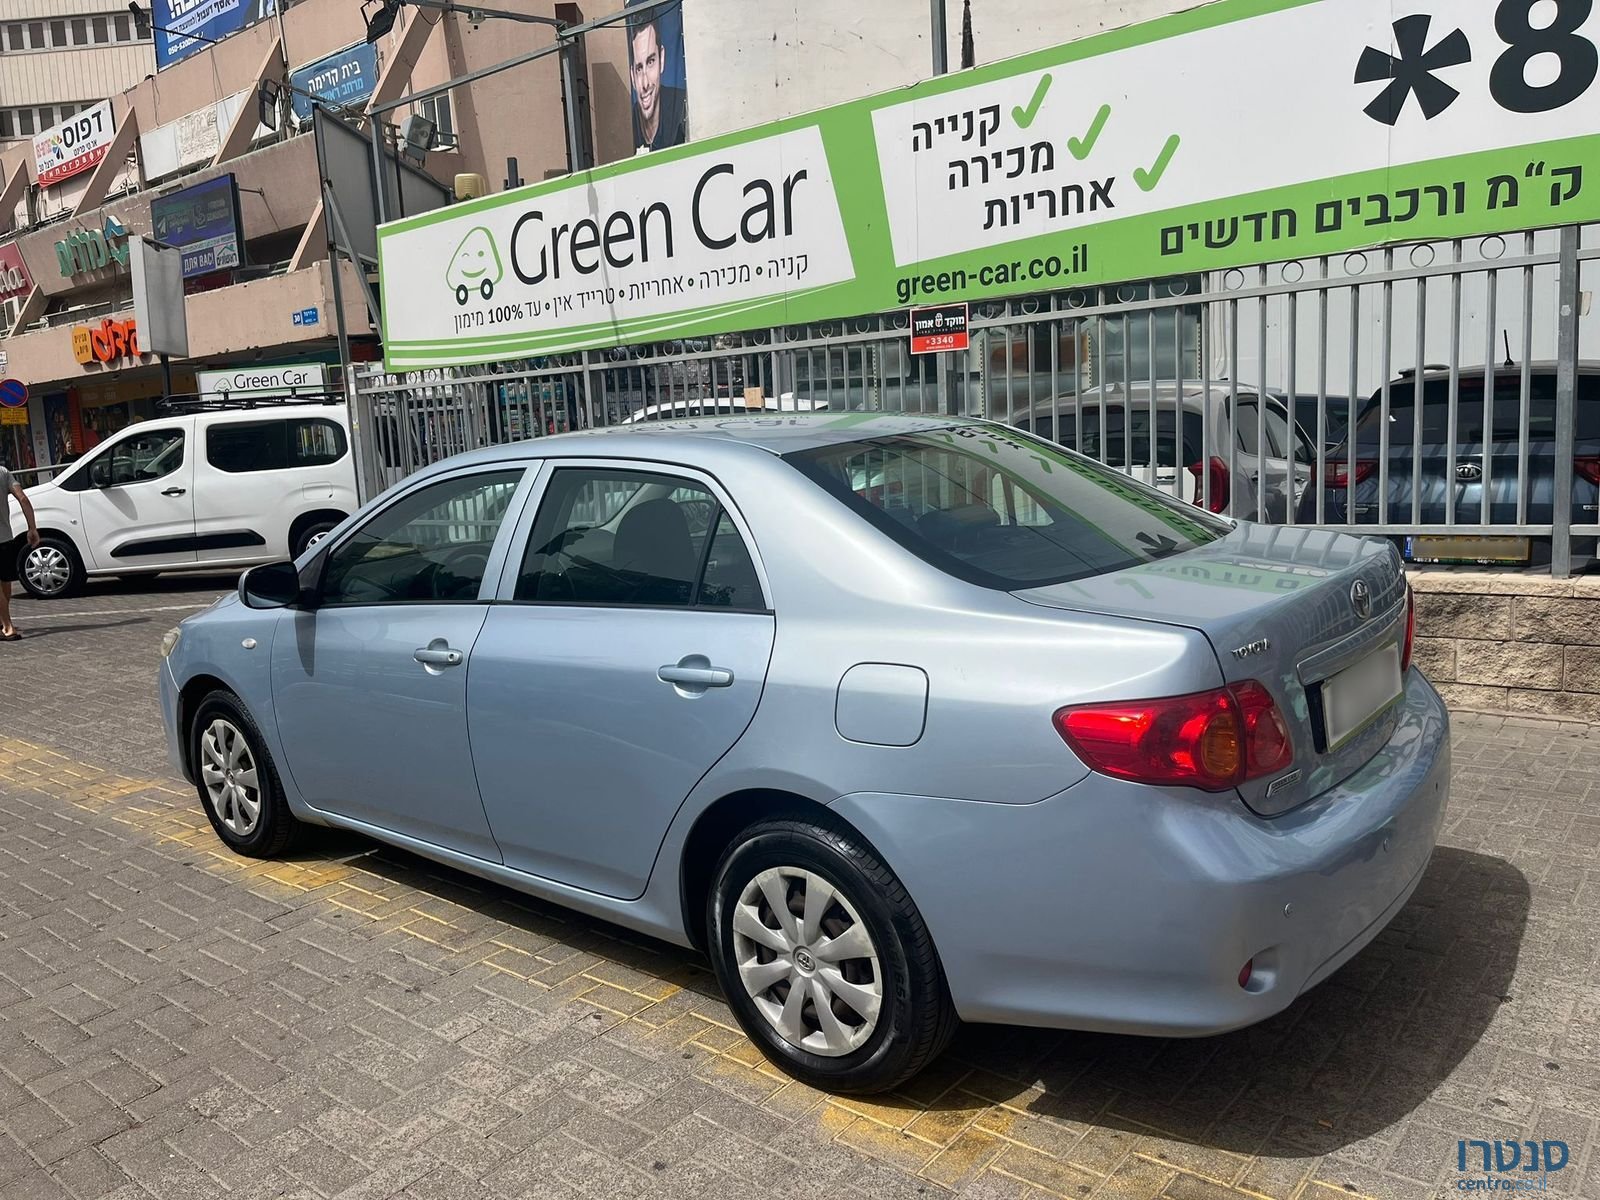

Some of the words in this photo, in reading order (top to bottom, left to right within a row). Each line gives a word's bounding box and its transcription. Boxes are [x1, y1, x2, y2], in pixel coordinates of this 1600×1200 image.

[307, 68, 338, 93] קדימה
[341, 60, 361, 79] בית
[341, 77, 364, 96] מרחב
[62, 111, 102, 148] דפוס
[912, 103, 1001, 153] קנייה
[948, 141, 1055, 190] מכירה
[983, 176, 1116, 230] אחריות
[1315, 181, 1465, 235] ורכבים
[510, 201, 674, 286] Green
[692, 163, 808, 250] Car
[1160, 207, 1297, 256] חדשים
[184, 257, 198, 273] ДЛЯ
[698, 263, 751, 290] מכירה
[767, 252, 809, 280] קניה
[896, 243, 1089, 305] green-car.co.il
[576, 285, 615, 310] טרייד
[629, 275, 684, 302] אחריות
[488, 303, 523, 324] 100%
[525, 300, 542, 318] עד
[553, 293, 573, 318] אין
[454, 310, 484, 334] מימון
[915, 319, 933, 332] אמון
[944, 316, 965, 328] מוקד
[233, 373, 279, 389] Green
[282, 370, 308, 385] Car
